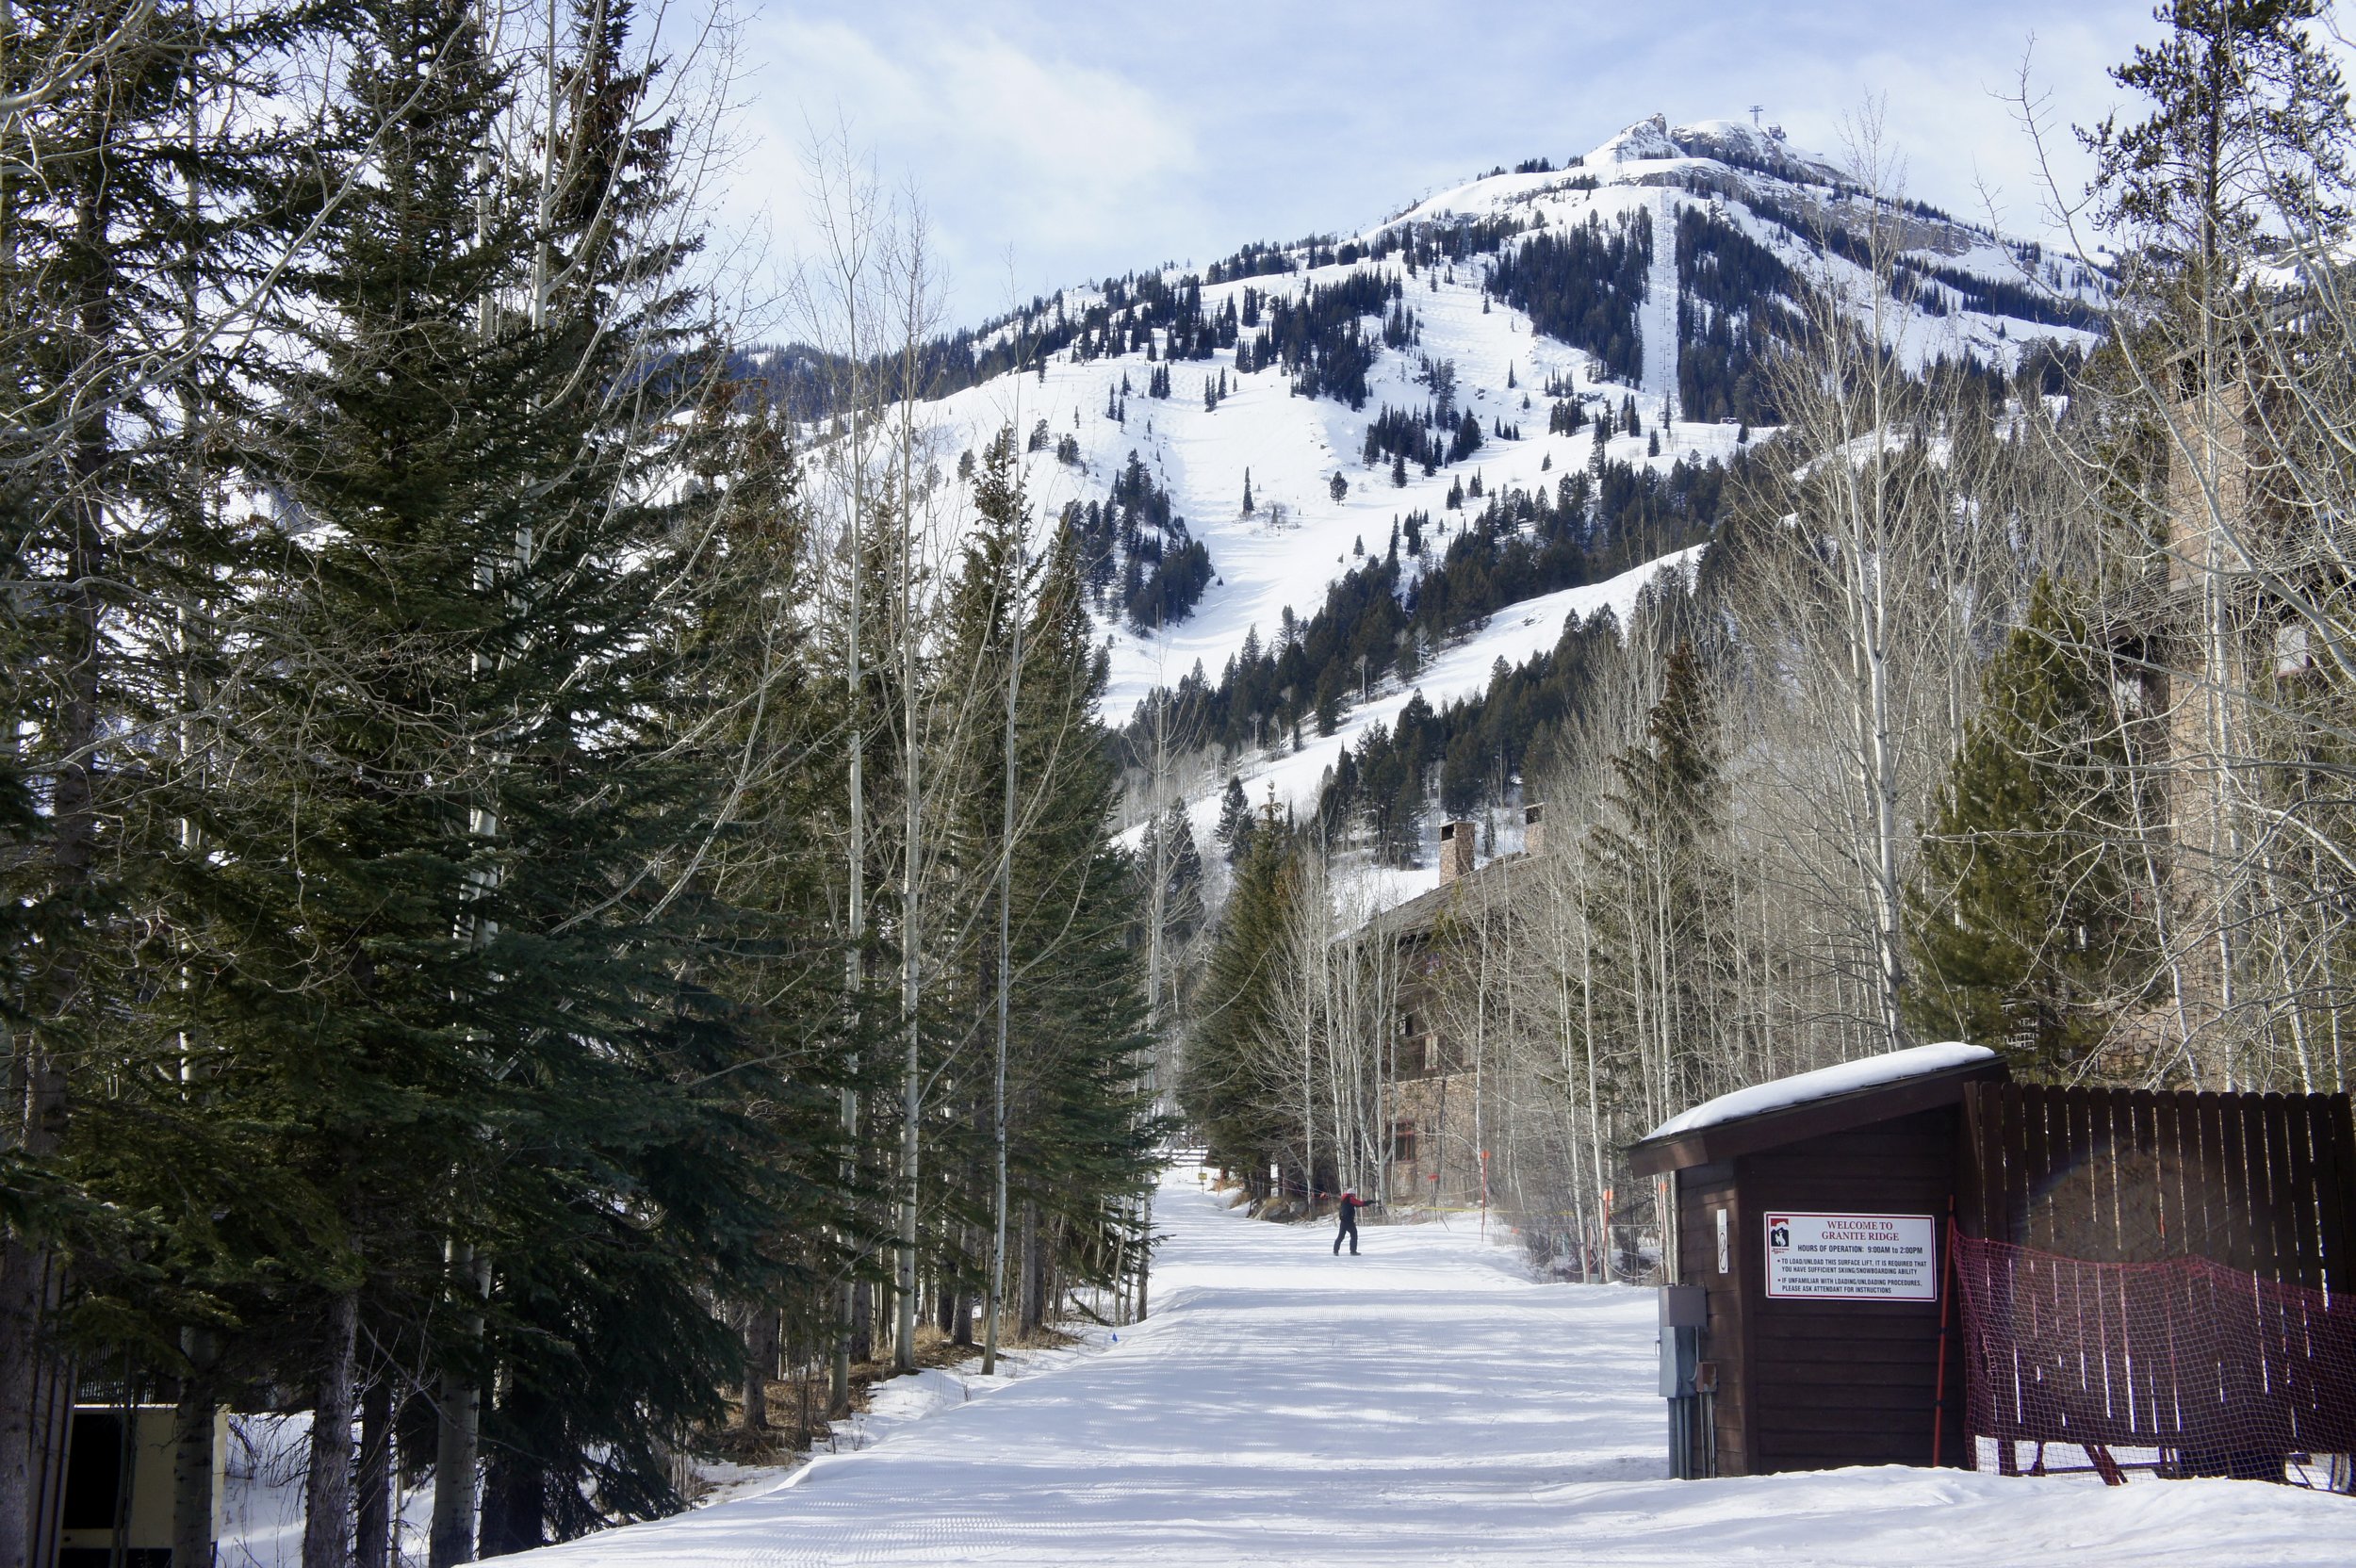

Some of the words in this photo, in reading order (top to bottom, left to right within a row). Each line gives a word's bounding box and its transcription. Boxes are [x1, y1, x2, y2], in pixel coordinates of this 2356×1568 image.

[1827, 1220, 1877, 1230] WELCOME
[1879, 1221, 1893, 1231] TO
[1822, 1231, 1866, 1240] GRANITE
[1868, 1233, 1900, 1241] RIDGE
[1828, 1245, 1865, 1253] OPERATION:
